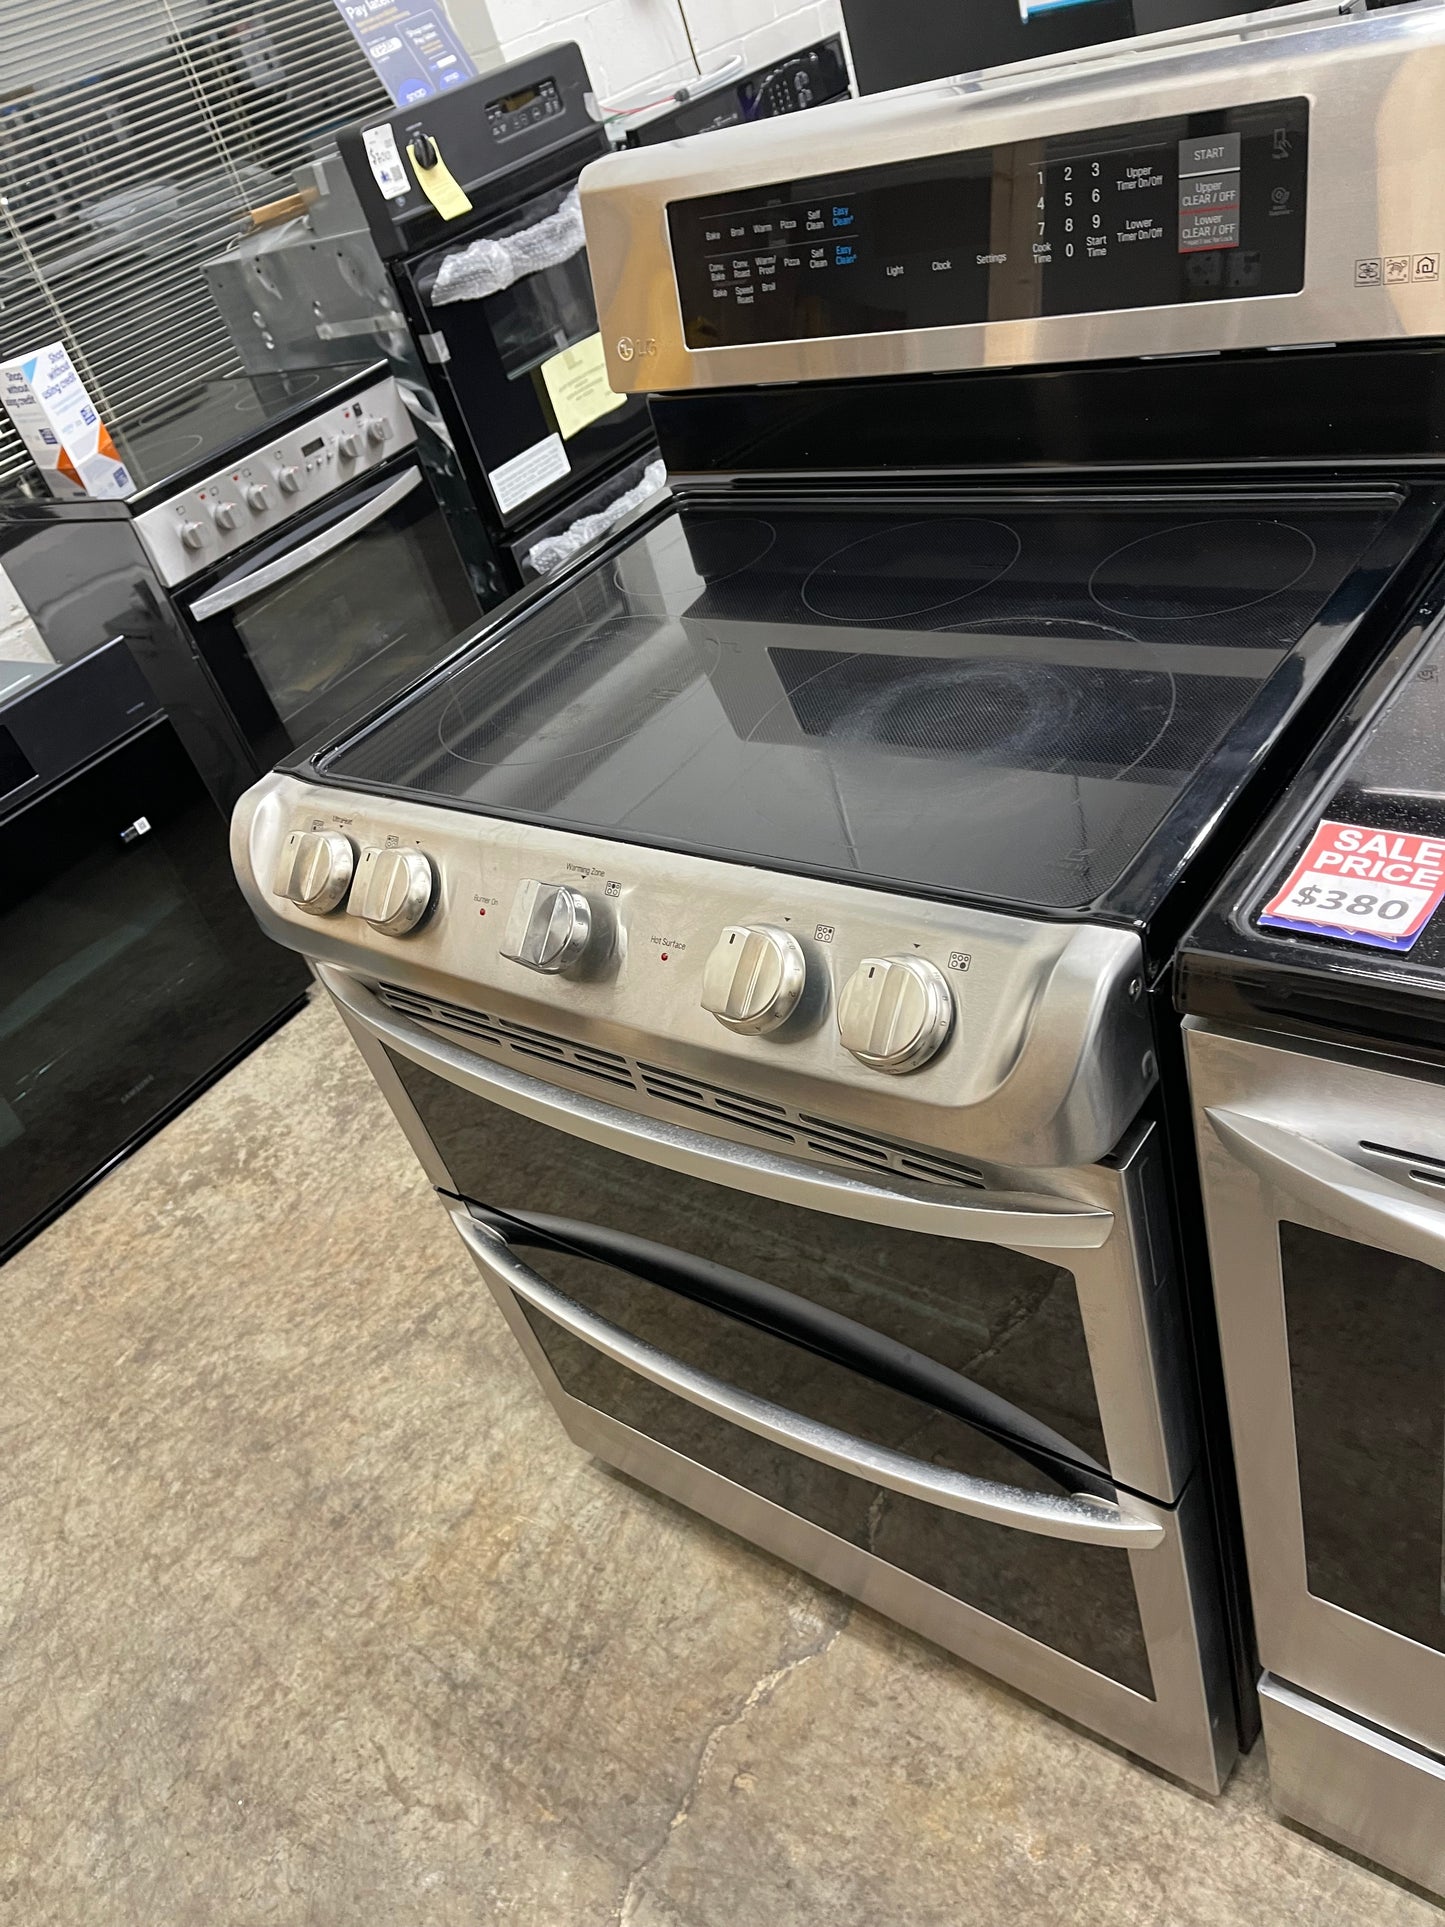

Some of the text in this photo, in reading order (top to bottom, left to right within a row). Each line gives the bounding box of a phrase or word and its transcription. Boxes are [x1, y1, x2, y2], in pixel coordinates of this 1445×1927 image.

[345, 4, 369, 20] Pay
[1193, 146, 1225, 161] START
[1064, 167, 1073, 181] 2
[1091, 163, 1100, 178] 3
[1126, 165, 1153, 181] Upper
[1036, 171, 1044, 185] 1
[1116, 174, 1163, 192] Timer On/Off
[1195, 180, 1223, 195] Upper
[1064, 192, 1073, 207] 5
[1091, 189, 1101, 203] 6
[1182, 192, 1211, 207] CLEAR
[1218, 189, 1237, 204] OFF
[1036, 196, 1045, 211] 4
[832, 206, 849, 217] Easy
[806, 221, 825, 231] Clean
[1064, 218, 1074, 233] 8
[1092, 214, 1101, 229] 9
[1125, 217, 1153, 231] Lower
[1194, 213, 1223, 227] Lower
[730, 226, 745, 237] Broil
[753, 223, 773, 233] Warm
[1037, 222, 1046, 236] 7
[1116, 227, 1163, 243] Timer On/Off
[1182, 224, 1211, 239] CLEAR
[1218, 222, 1237, 236] OFF
[705, 231, 721, 241] Bake
[1086, 234, 1107, 248] Start
[1032, 242, 1052, 254] Cook
[1065, 243, 1074, 258] 0
[1086, 245, 1107, 258] Time
[783, 257, 801, 267] Pizza
[809, 259, 829, 269] Clean
[976, 251, 1007, 266] Settings
[1033, 252, 1052, 264] Time
[886, 264, 904, 278] Light
[932, 260, 952, 272] Clock
[711, 272, 726, 281] Bake
[712, 288, 728, 298] Bake
[1333, 829, 1445, 867] SALE
[566, 862, 606, 878] Warming Zone
[1313, 850, 1444, 888] PRICE
[473, 893, 499, 906] Burner On
[1291, 884, 1410, 920] $380
[650, 935, 686, 951] Hot Surface
